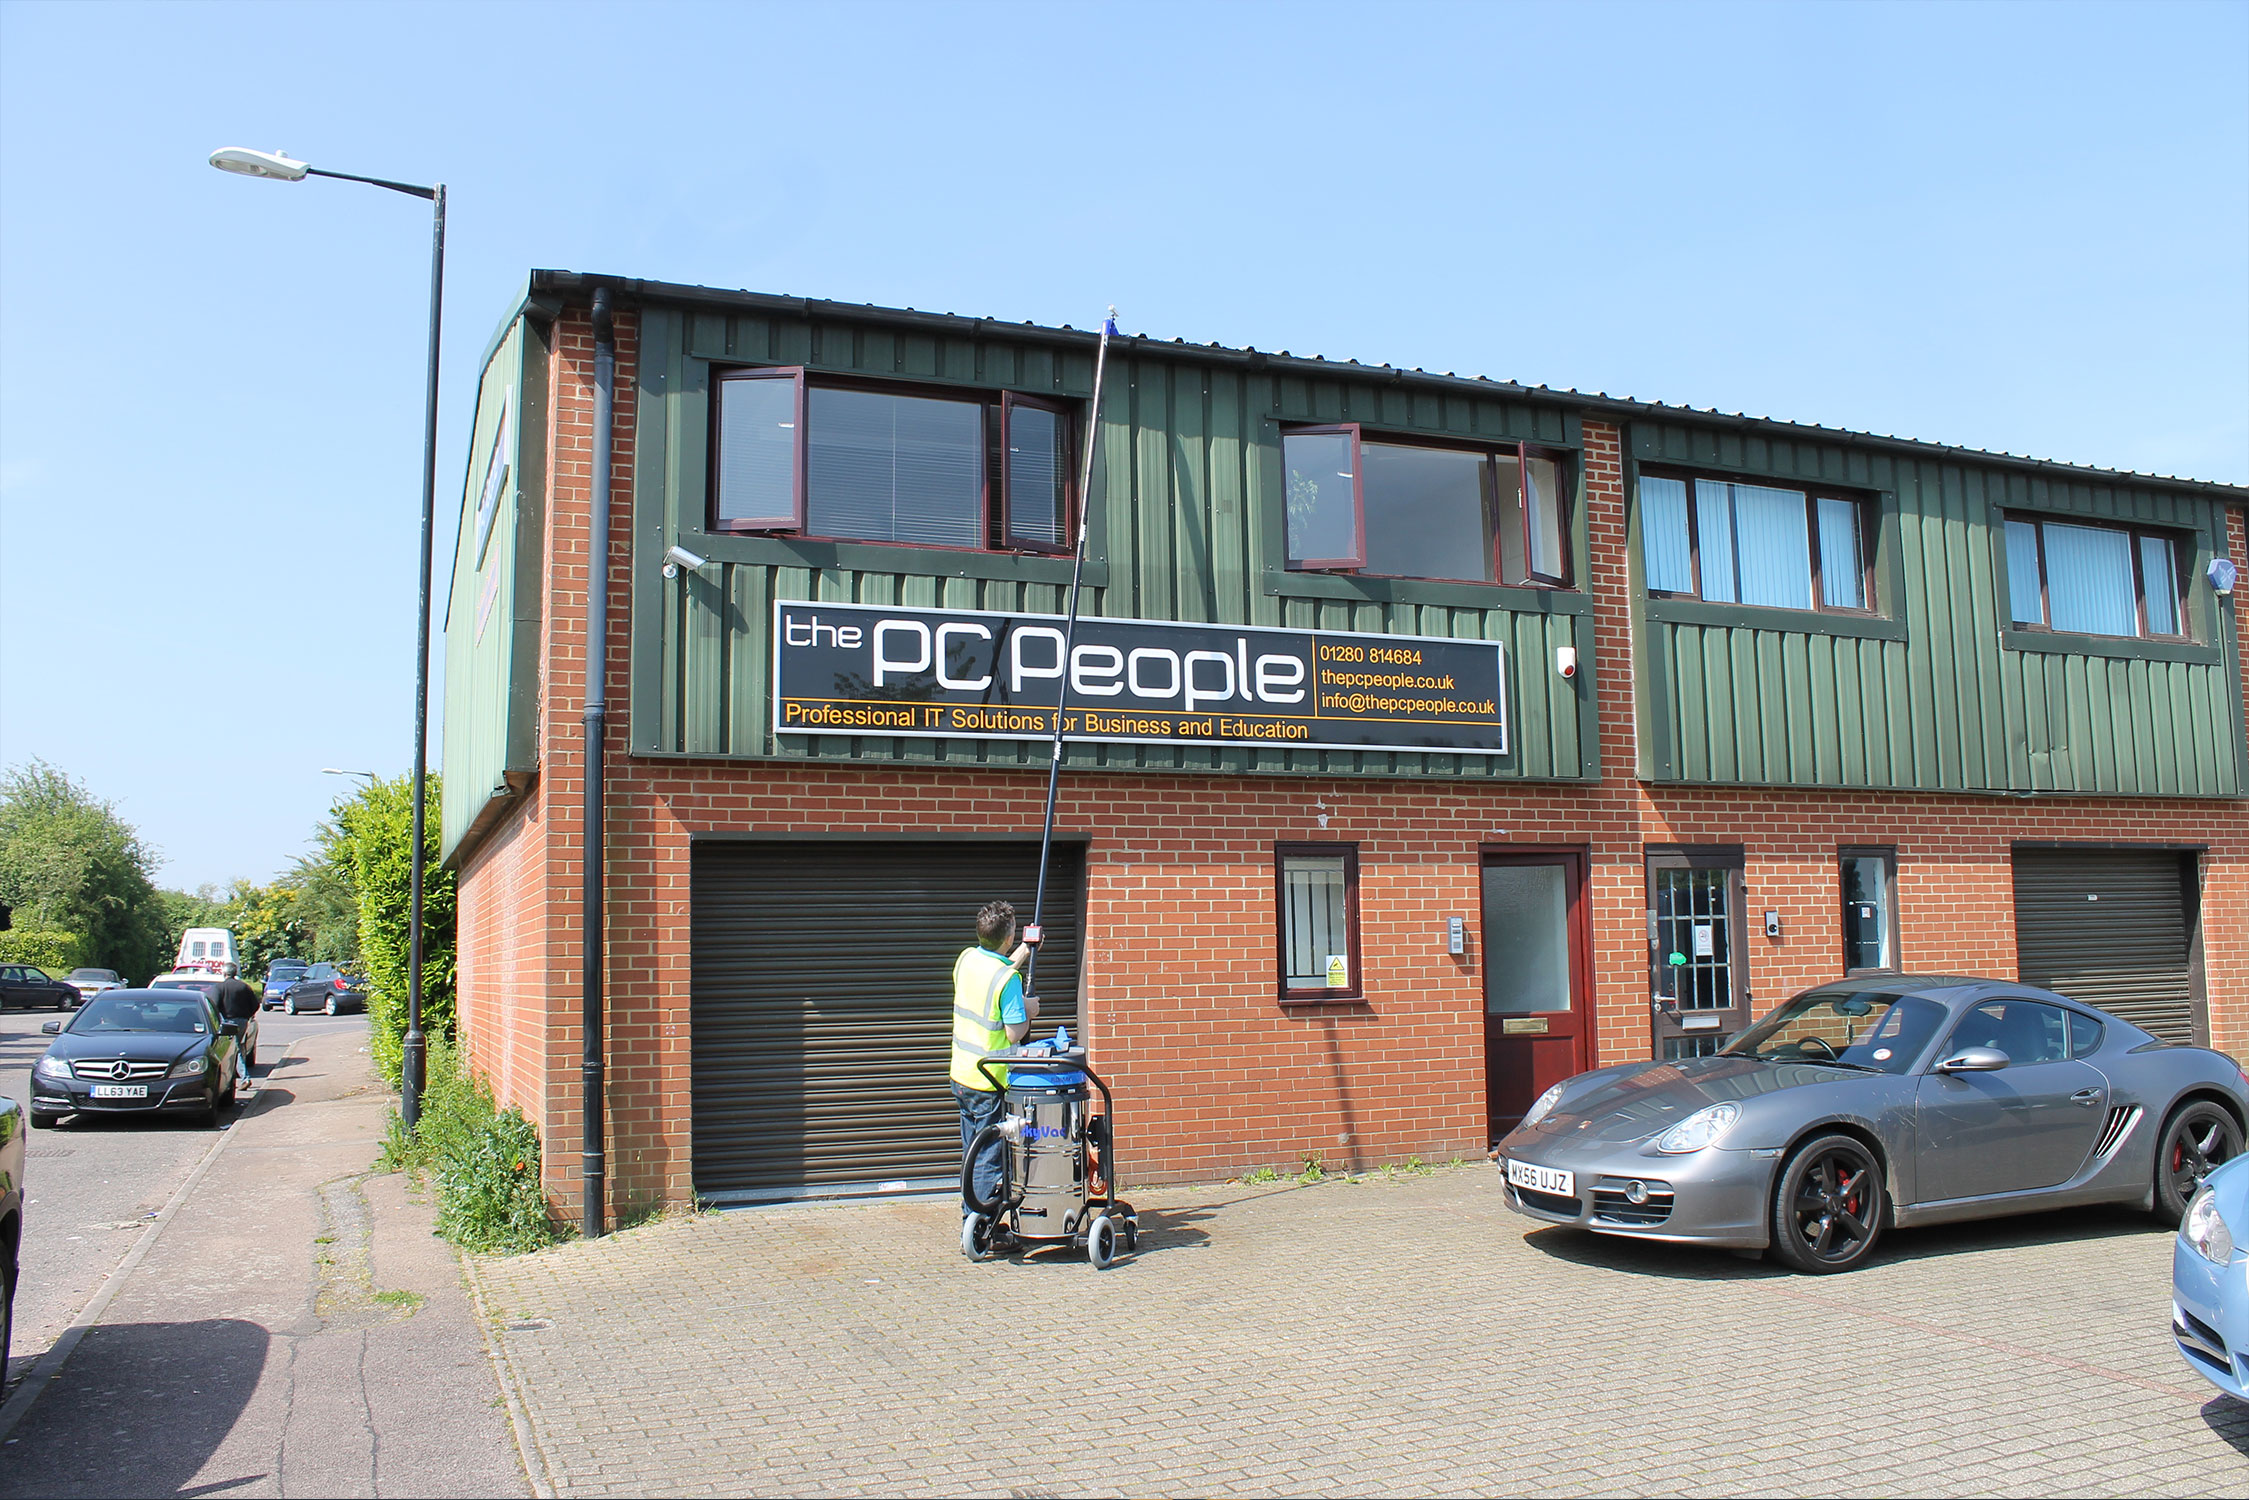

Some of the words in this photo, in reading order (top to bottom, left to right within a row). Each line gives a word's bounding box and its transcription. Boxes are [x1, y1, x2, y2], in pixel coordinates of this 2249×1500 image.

[785, 614, 863, 649] the
[873, 618, 993, 691] PC
[1011, 625, 1305, 711] People
[1320, 645, 1364, 663] 01280
[1369, 647, 1423, 666] 814684
[1321, 669, 1456, 691] thepcpeople.co.uk
[1321, 692, 1496, 716] info@thepcpeople.co.uk
[785, 703, 915, 727] Professional
[924, 707, 944, 727] IT
[951, 709, 1045, 731] Solutions
[1085, 713, 1172, 735] Business
[1178, 718, 1213, 736] and
[1220, 719, 1309, 739] Education
[97, 1087, 124, 1096] LL63
[126, 1087, 146, 1096] YAE
[1511, 1163, 1537, 1187] MX56
[1540, 1170, 1567, 1192] UJZ
